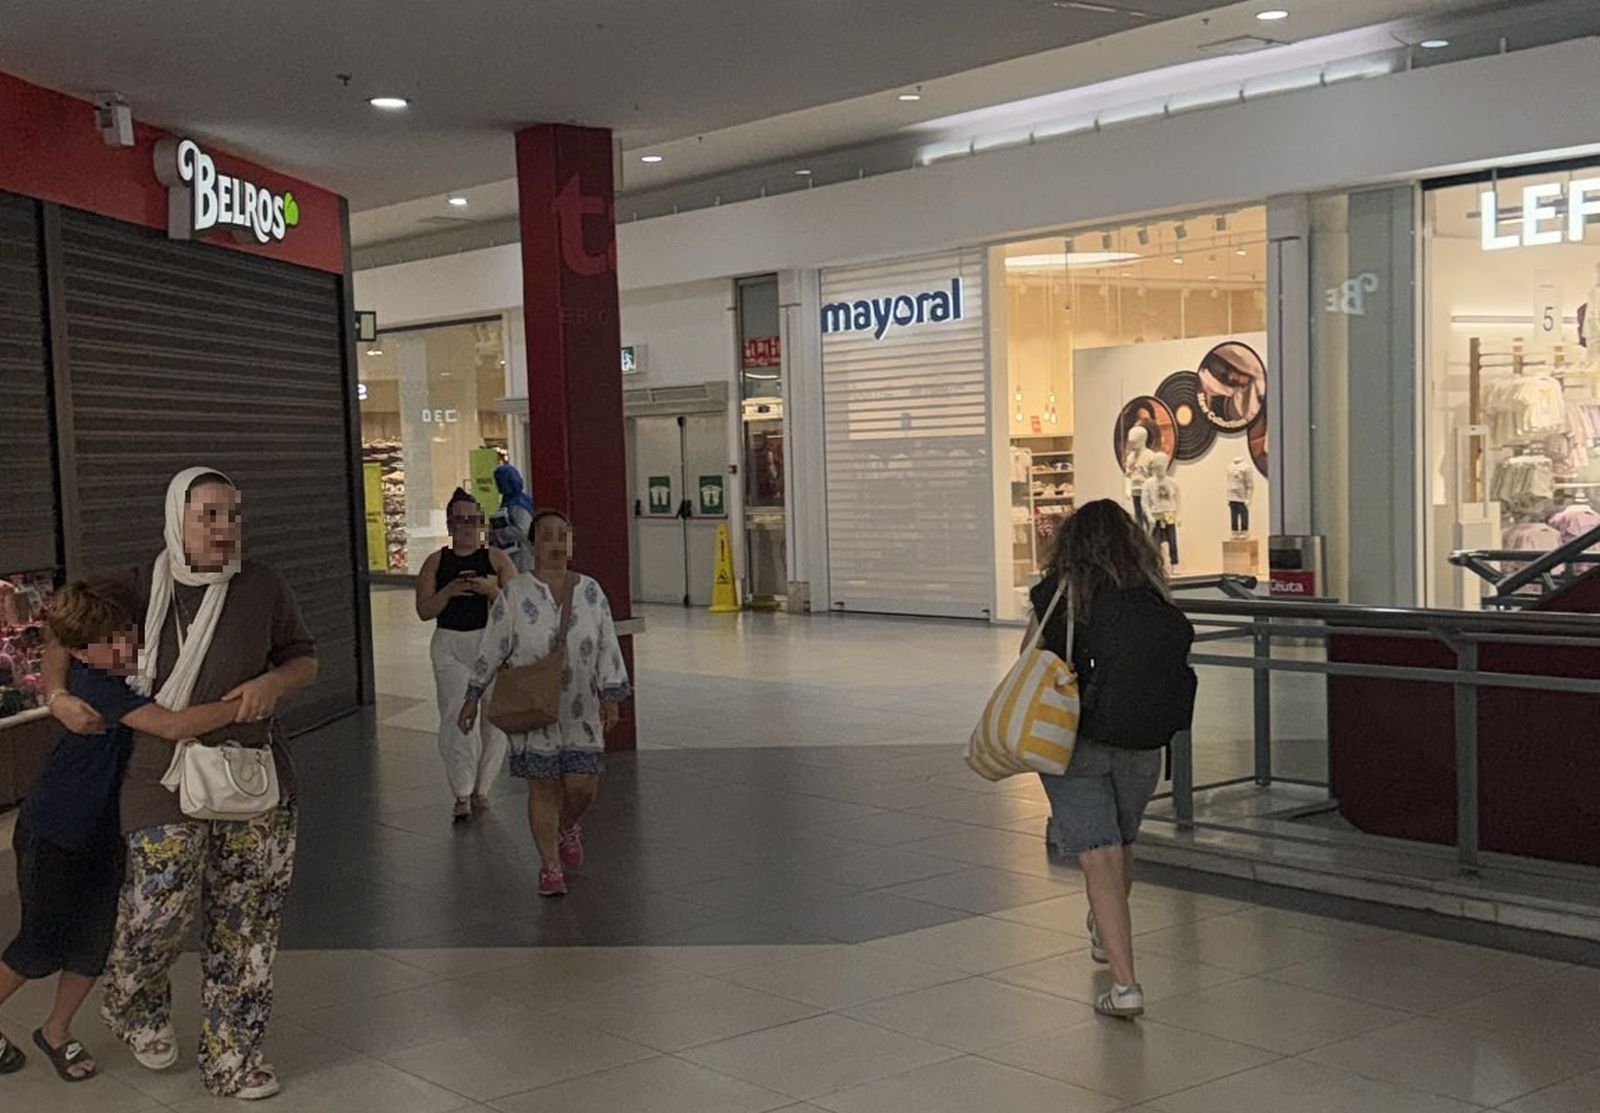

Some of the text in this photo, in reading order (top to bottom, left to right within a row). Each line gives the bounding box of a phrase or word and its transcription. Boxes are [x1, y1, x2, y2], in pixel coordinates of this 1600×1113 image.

[178, 140, 286, 243] BELROS
[549, 173, 617, 276] t
[1481, 177, 1600, 251] LEF
[821, 277, 963, 340] mayoral
[1542, 306, 1554, 332] 5
